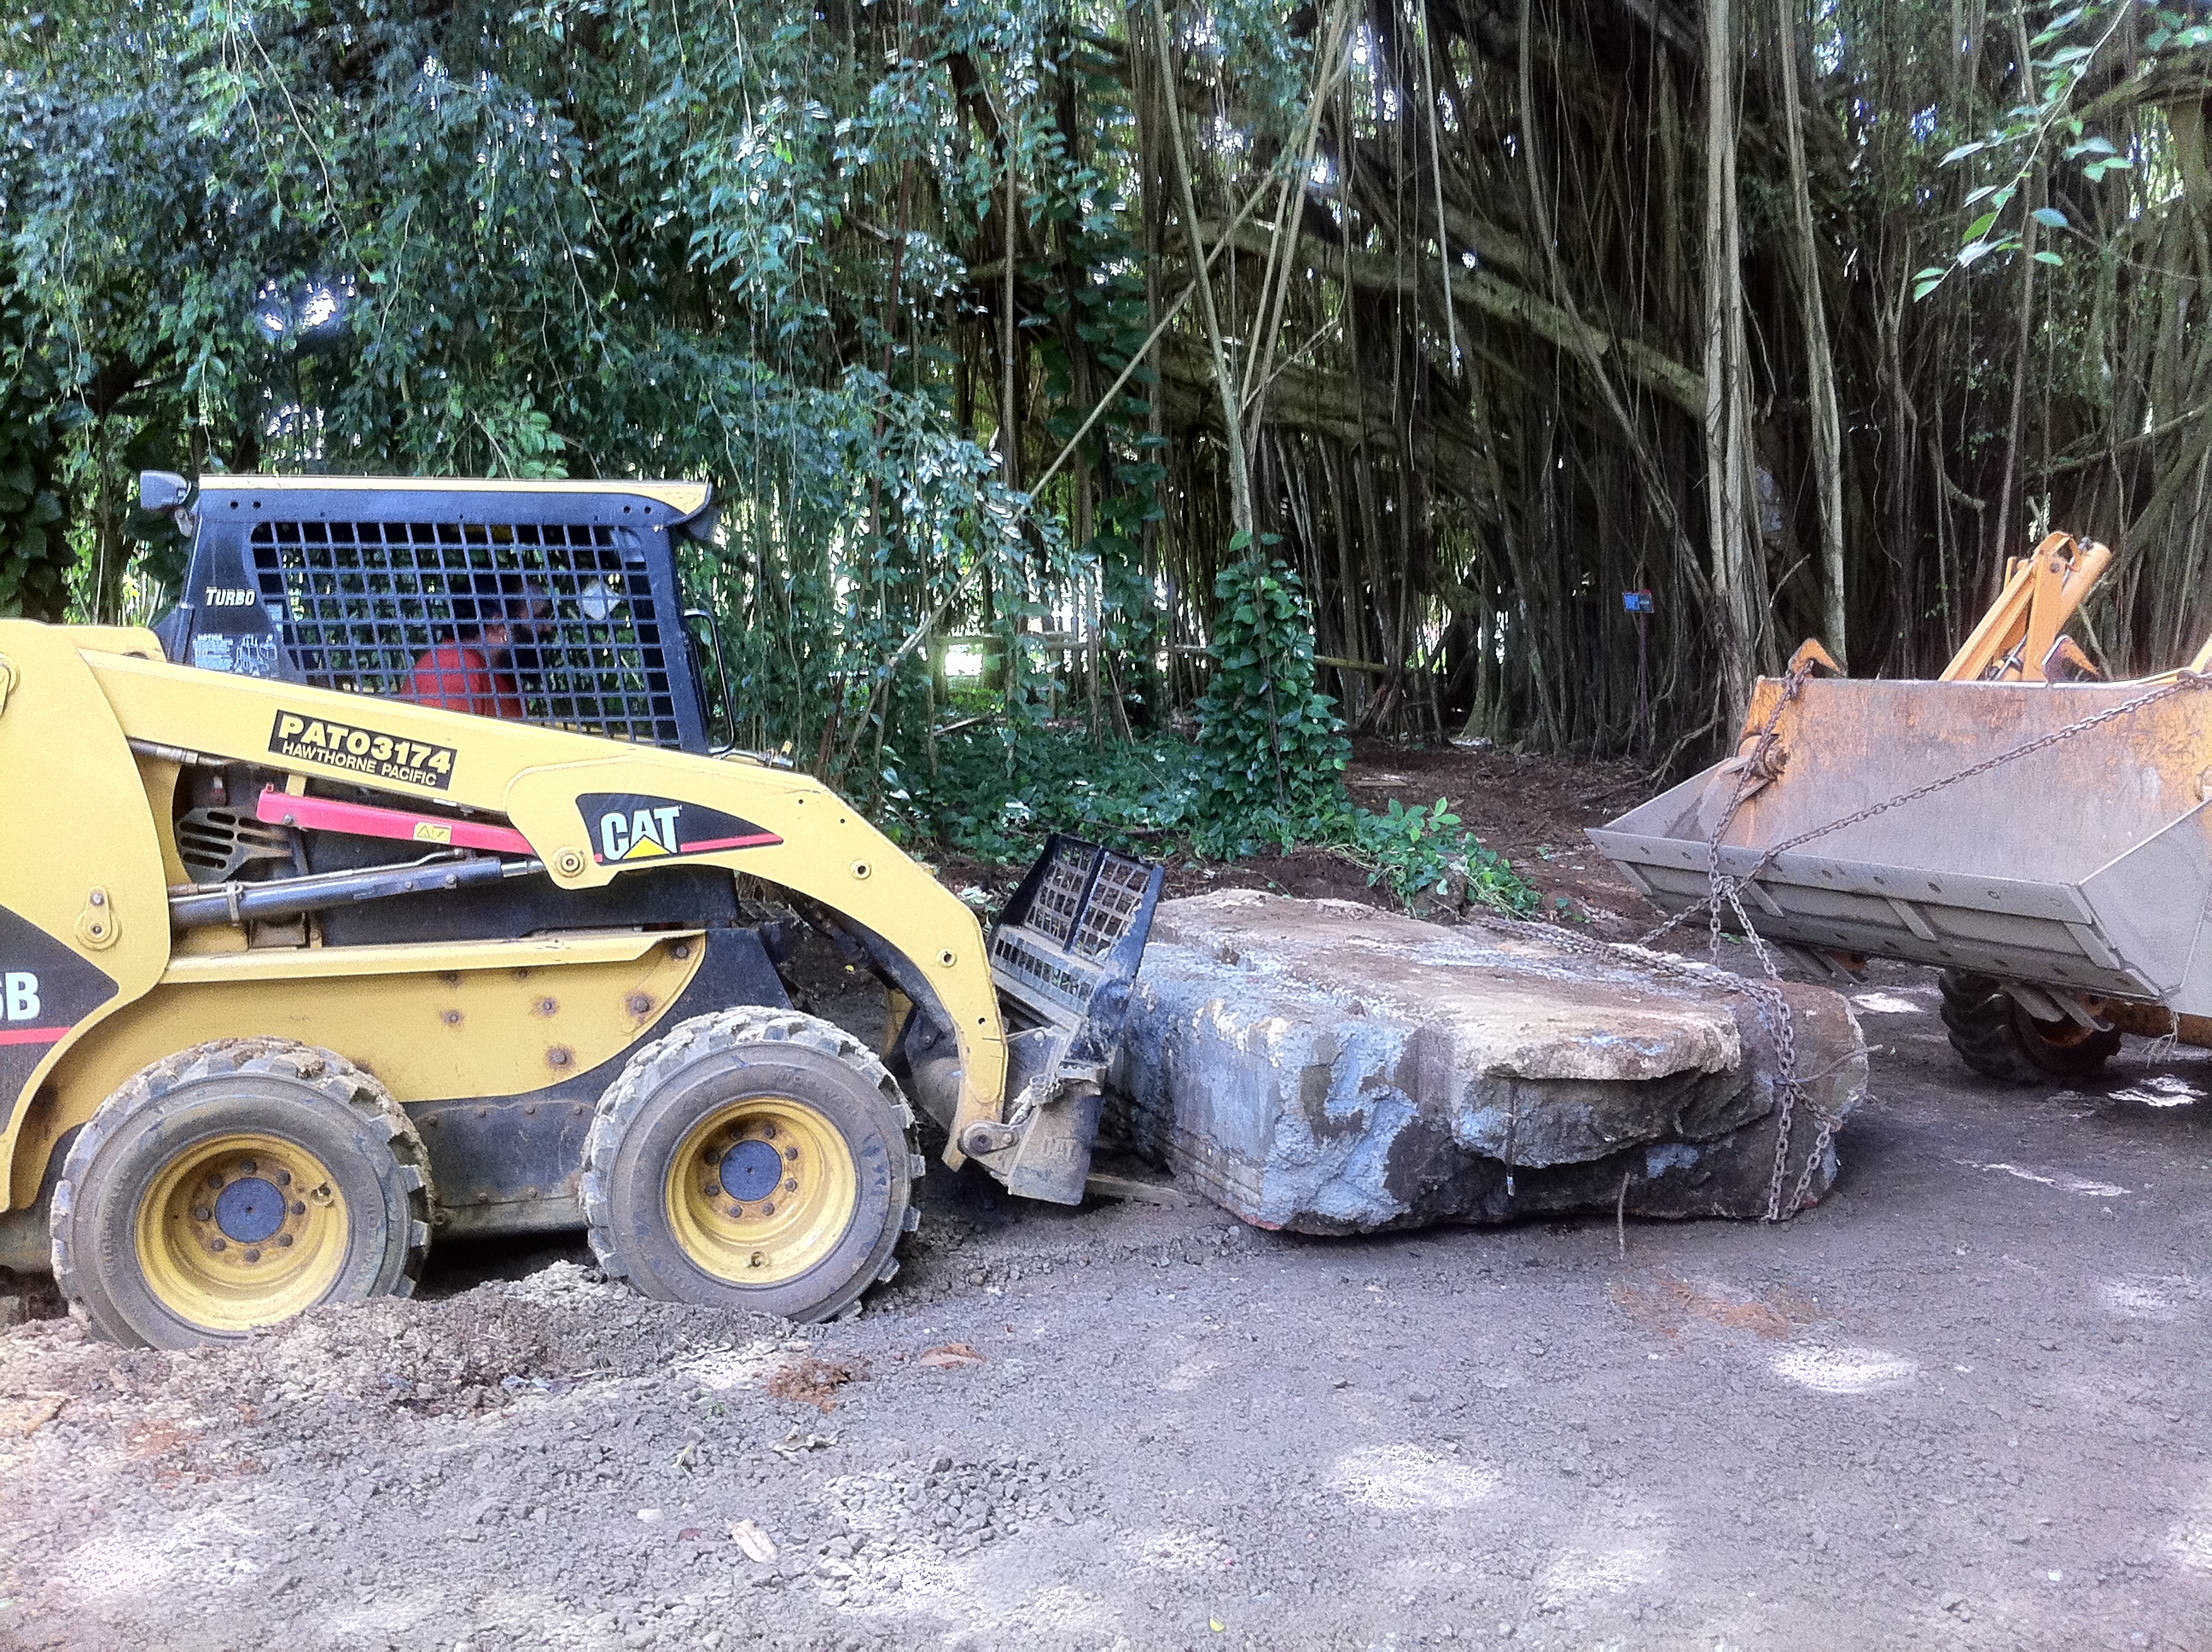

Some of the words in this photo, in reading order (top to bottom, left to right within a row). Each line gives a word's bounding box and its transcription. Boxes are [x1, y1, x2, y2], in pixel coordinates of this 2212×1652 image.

[206, 586, 255, 606] TURBO
[282, 741, 376, 774] HAWTHORNE
[381, 762, 437, 786] PACIFIC
[600, 806, 680, 861] CAT
[0, 972, 40, 1020] B
